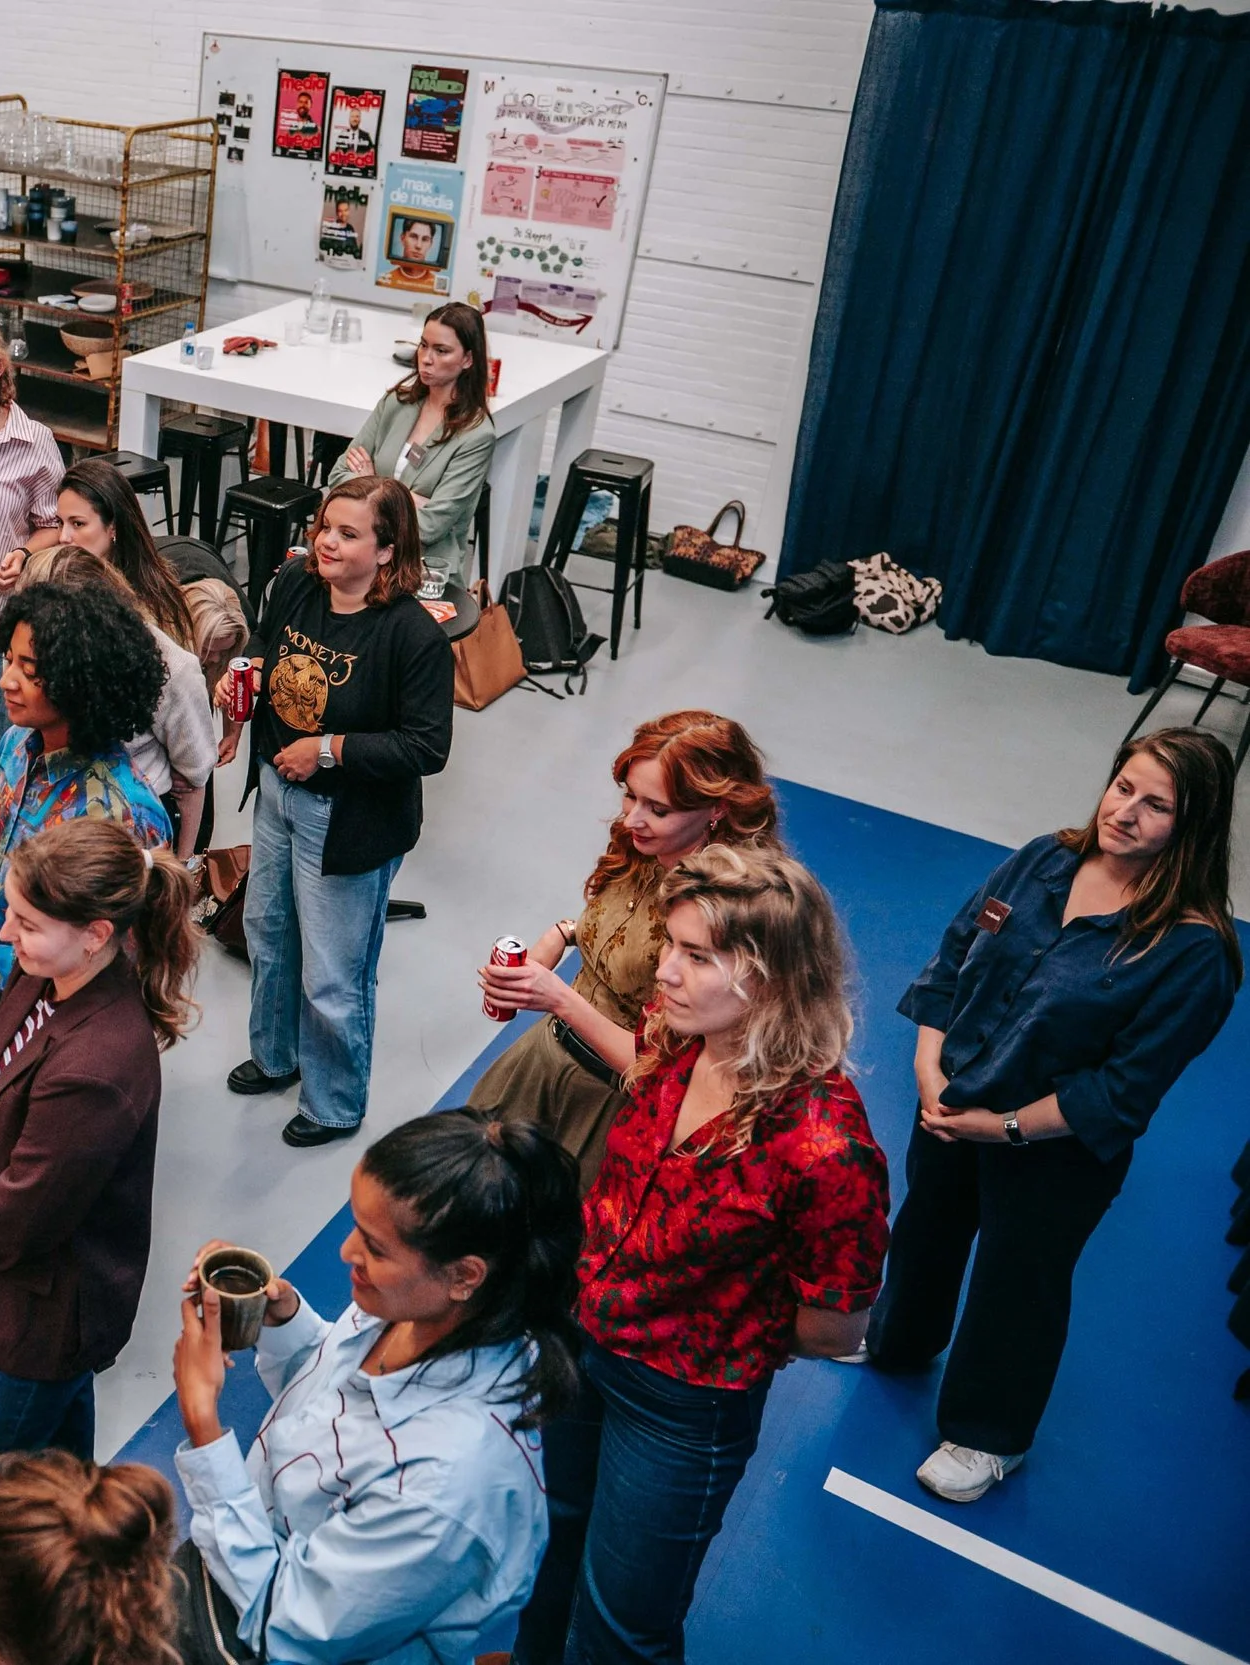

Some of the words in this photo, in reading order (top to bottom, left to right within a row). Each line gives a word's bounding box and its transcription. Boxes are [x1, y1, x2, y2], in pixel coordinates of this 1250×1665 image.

[281, 74, 327, 91] media
[335, 91, 382, 109] media
[276, 132, 321, 150] ahead
[329, 149, 375, 168] ahead
[402, 178, 432, 194] max
[391, 187, 408, 203] de
[411, 193, 454, 211] media
